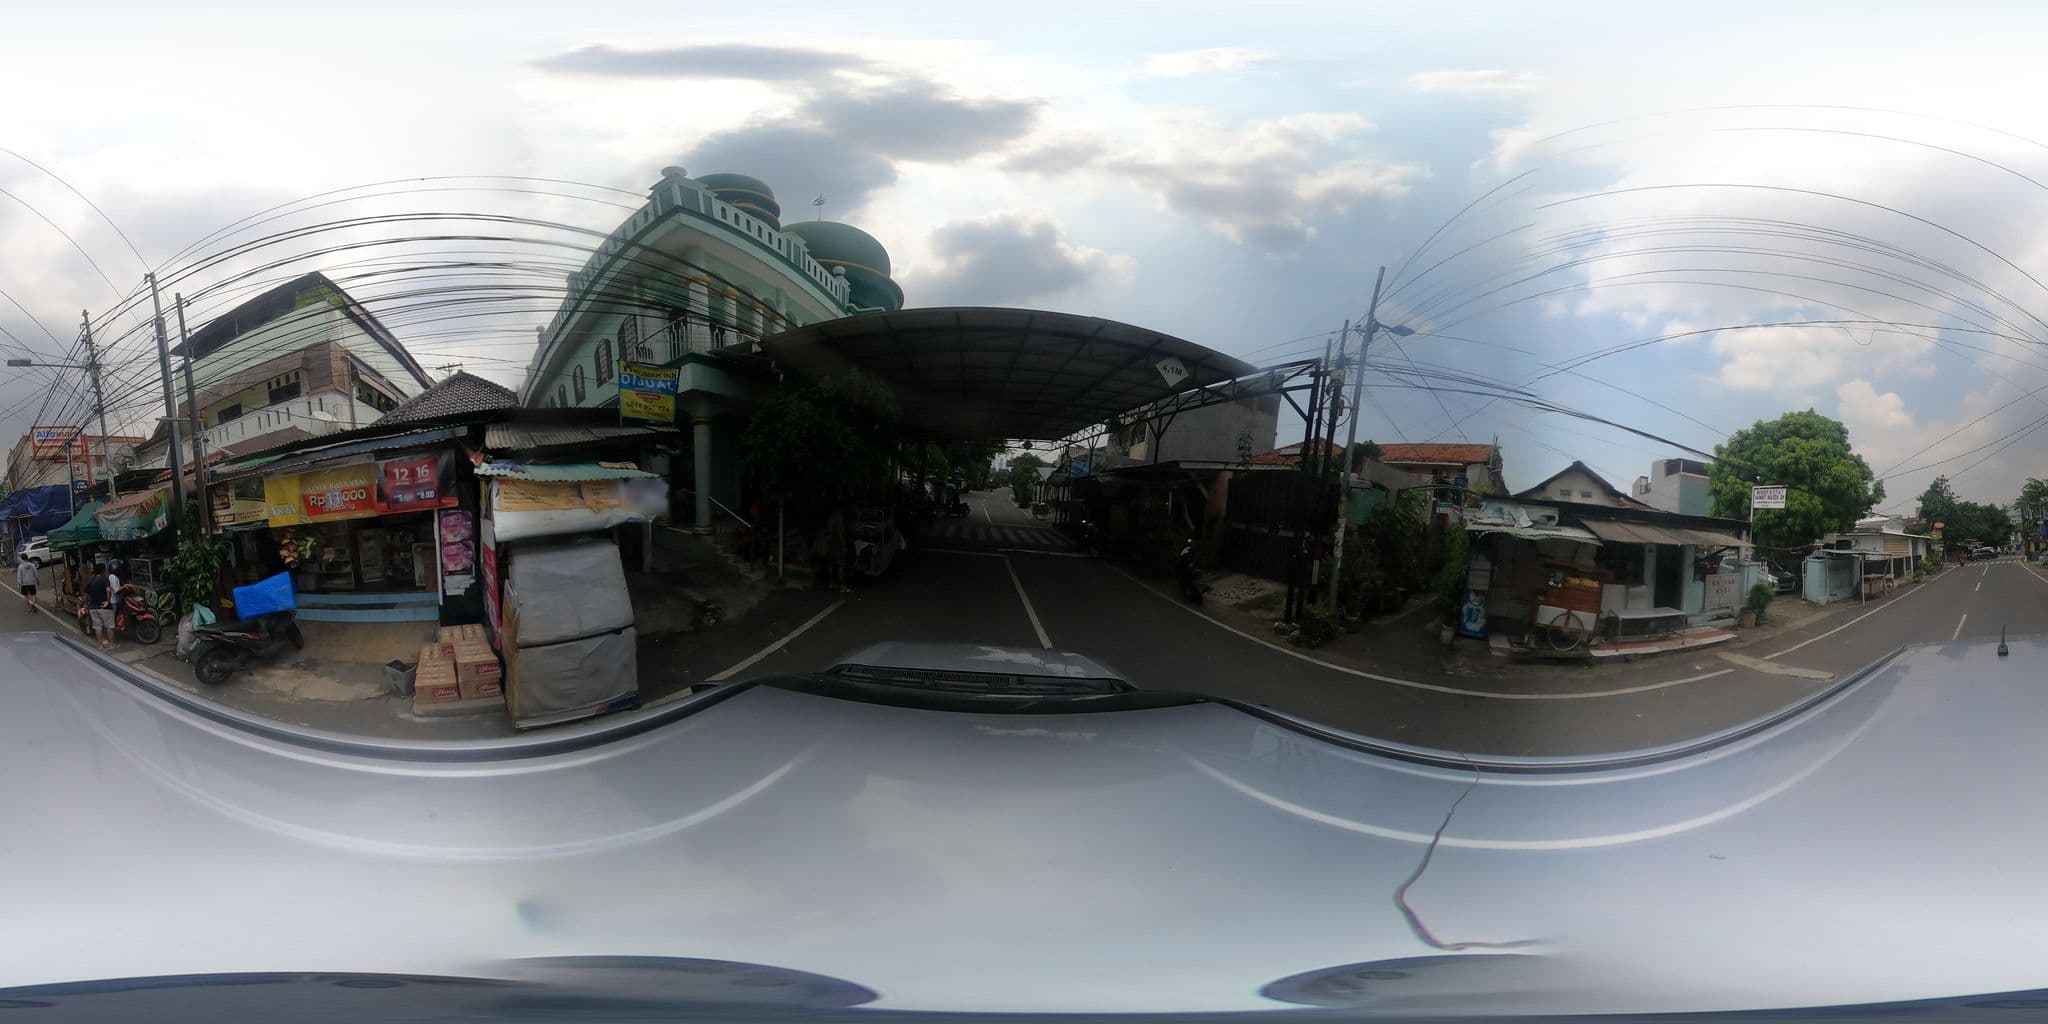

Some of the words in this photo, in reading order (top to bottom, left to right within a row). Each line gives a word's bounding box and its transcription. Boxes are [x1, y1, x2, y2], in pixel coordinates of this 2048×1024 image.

[621, 373, 674, 391] DIJUAL
[393, 467, 409, 481] 12
[415, 464, 430, 479] 16
